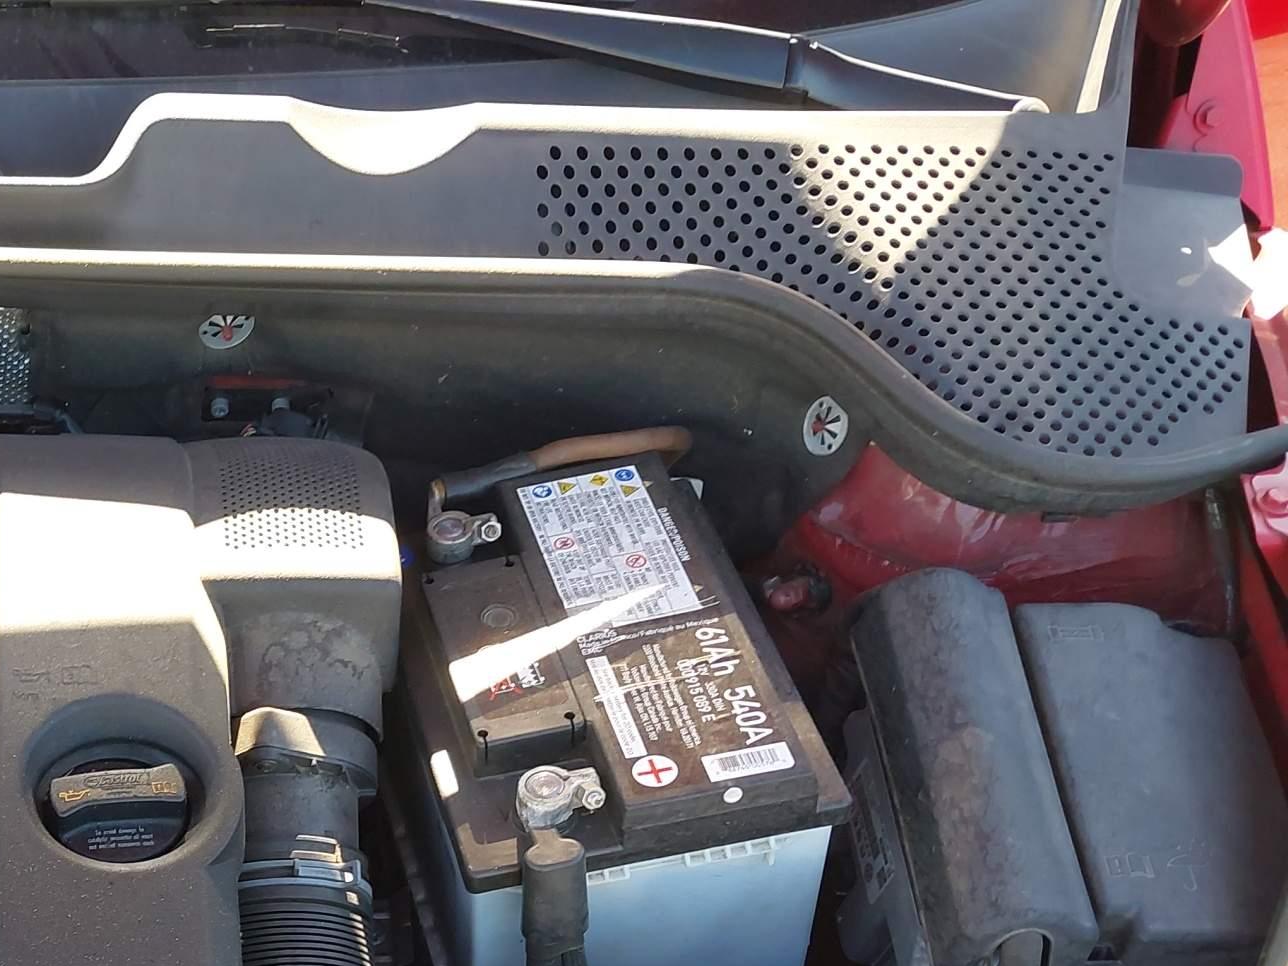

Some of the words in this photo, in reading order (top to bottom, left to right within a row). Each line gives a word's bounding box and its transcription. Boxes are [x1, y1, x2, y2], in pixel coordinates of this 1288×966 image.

[685, 675, 704, 695] 915
[695, 627, 740, 677] 61Ah
[723, 685, 774, 745] 540A
